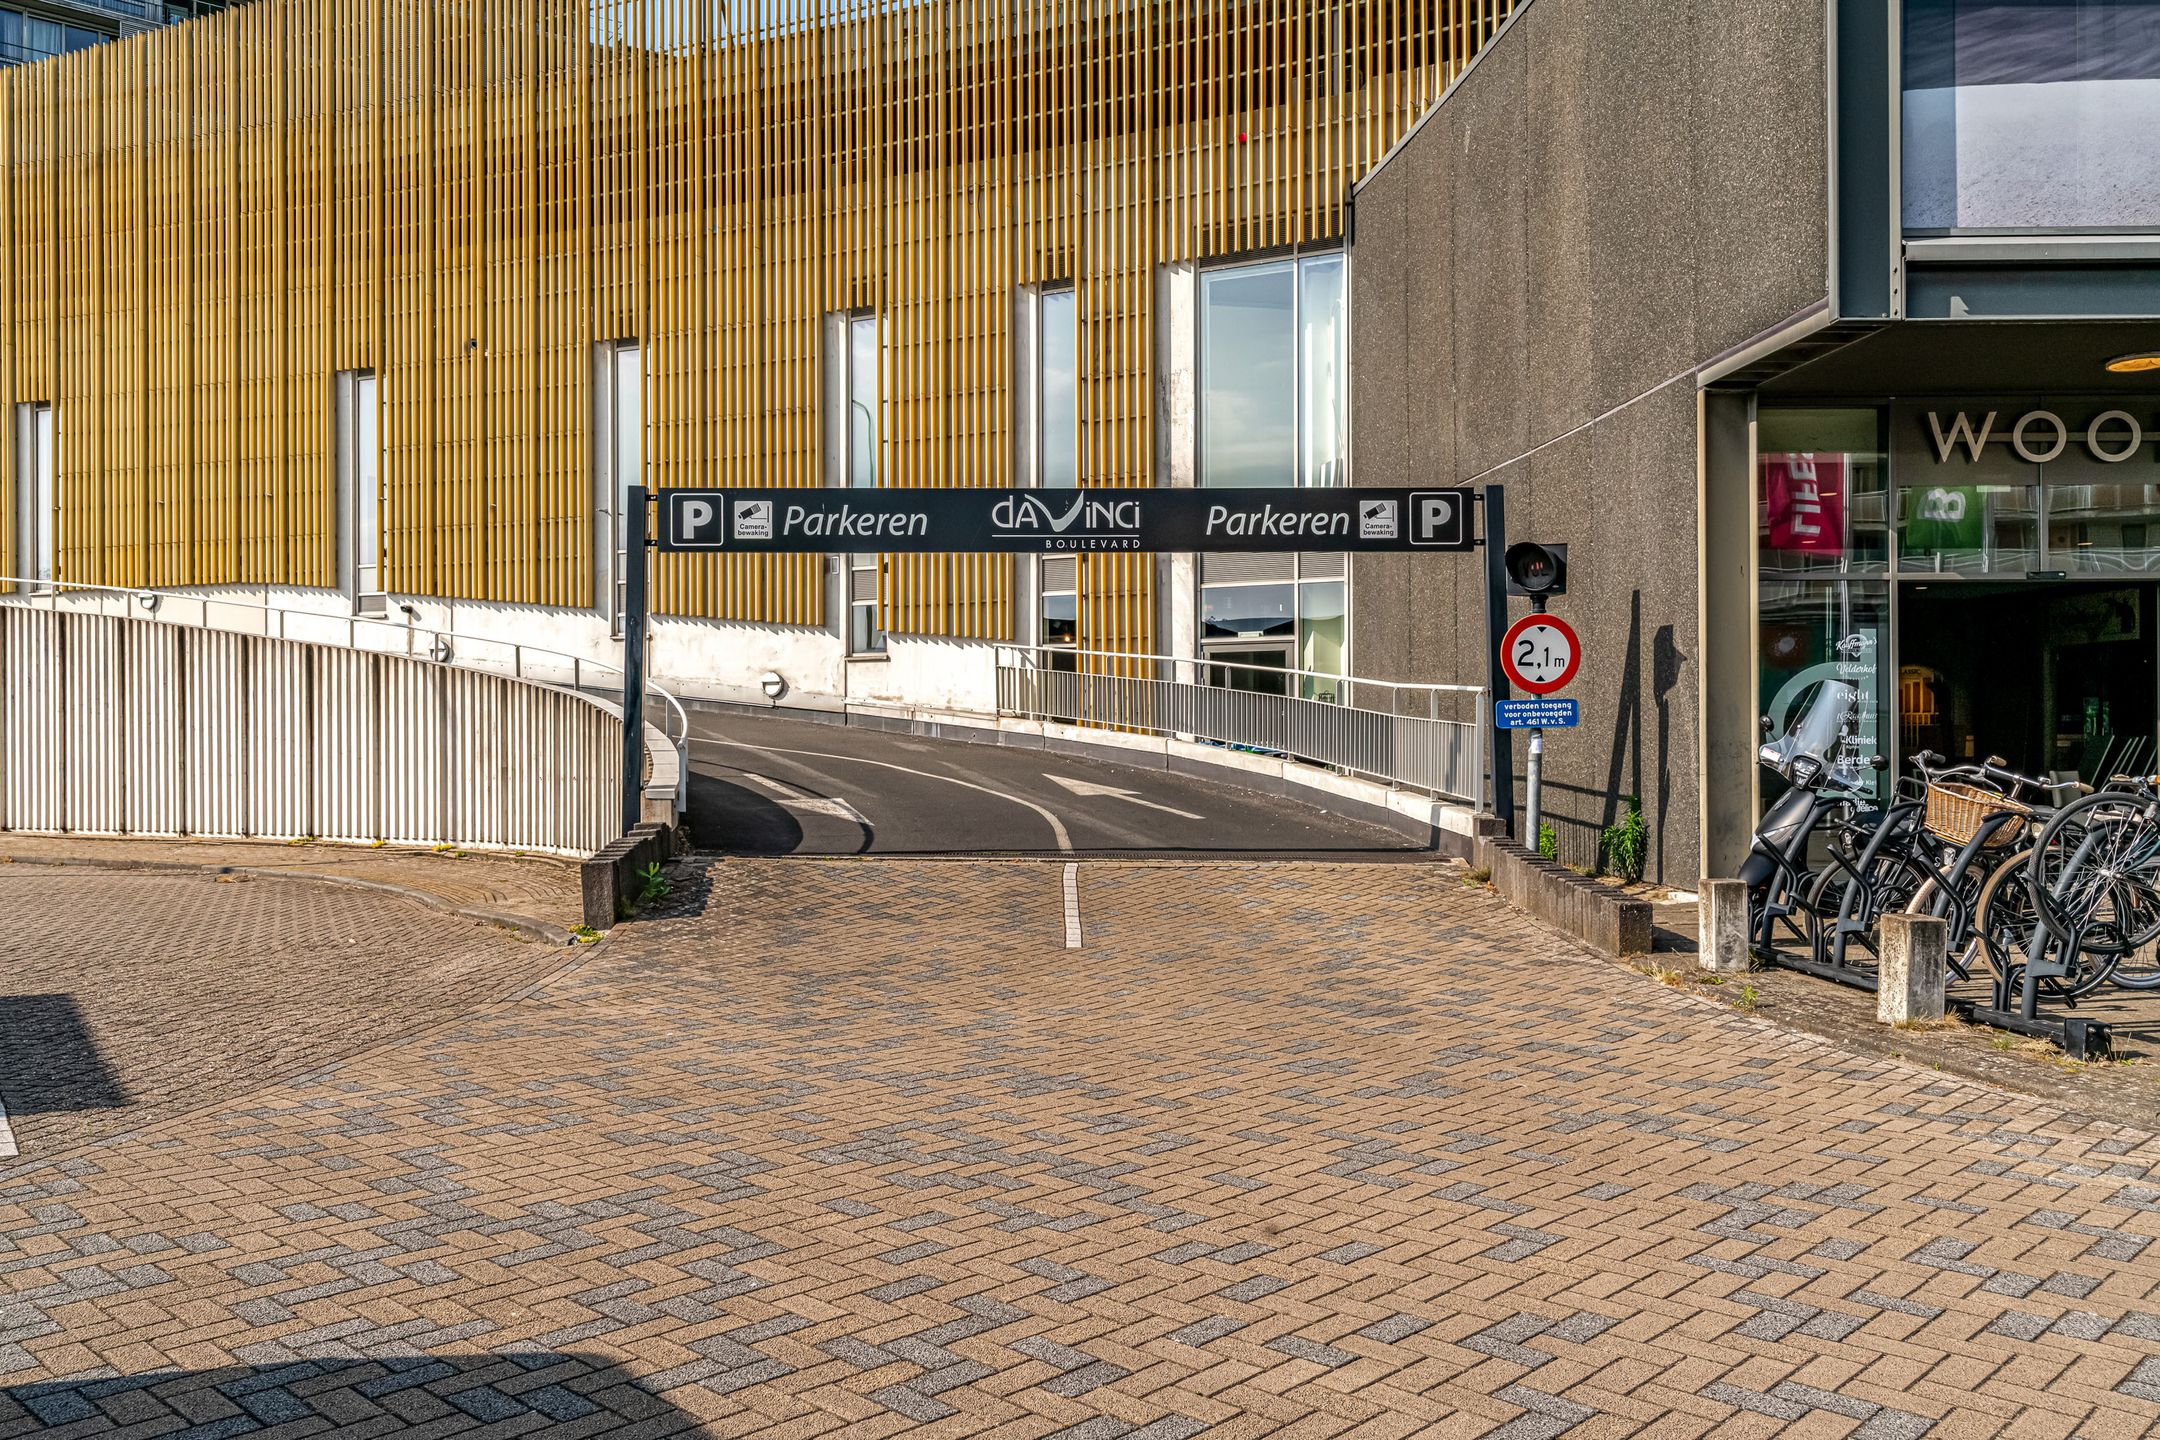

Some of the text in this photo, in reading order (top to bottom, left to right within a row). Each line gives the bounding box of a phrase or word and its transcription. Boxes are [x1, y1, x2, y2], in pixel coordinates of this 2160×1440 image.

[783, 504, 928, 537] Parkeren
[1205, 504, 1349, 537] Parkeren
[738, 530, 769, 538] bewaking
[1363, 530, 1394, 538] bewaking
[1046, 540, 1140, 548] BOULEVARD
[1541, 702, 1572, 710] toegang
[1523, 710, 1572, 718] onbevoegden
[1845, 735, 1877, 745] Kliniek
[1837, 755, 1871, 765] Berde
